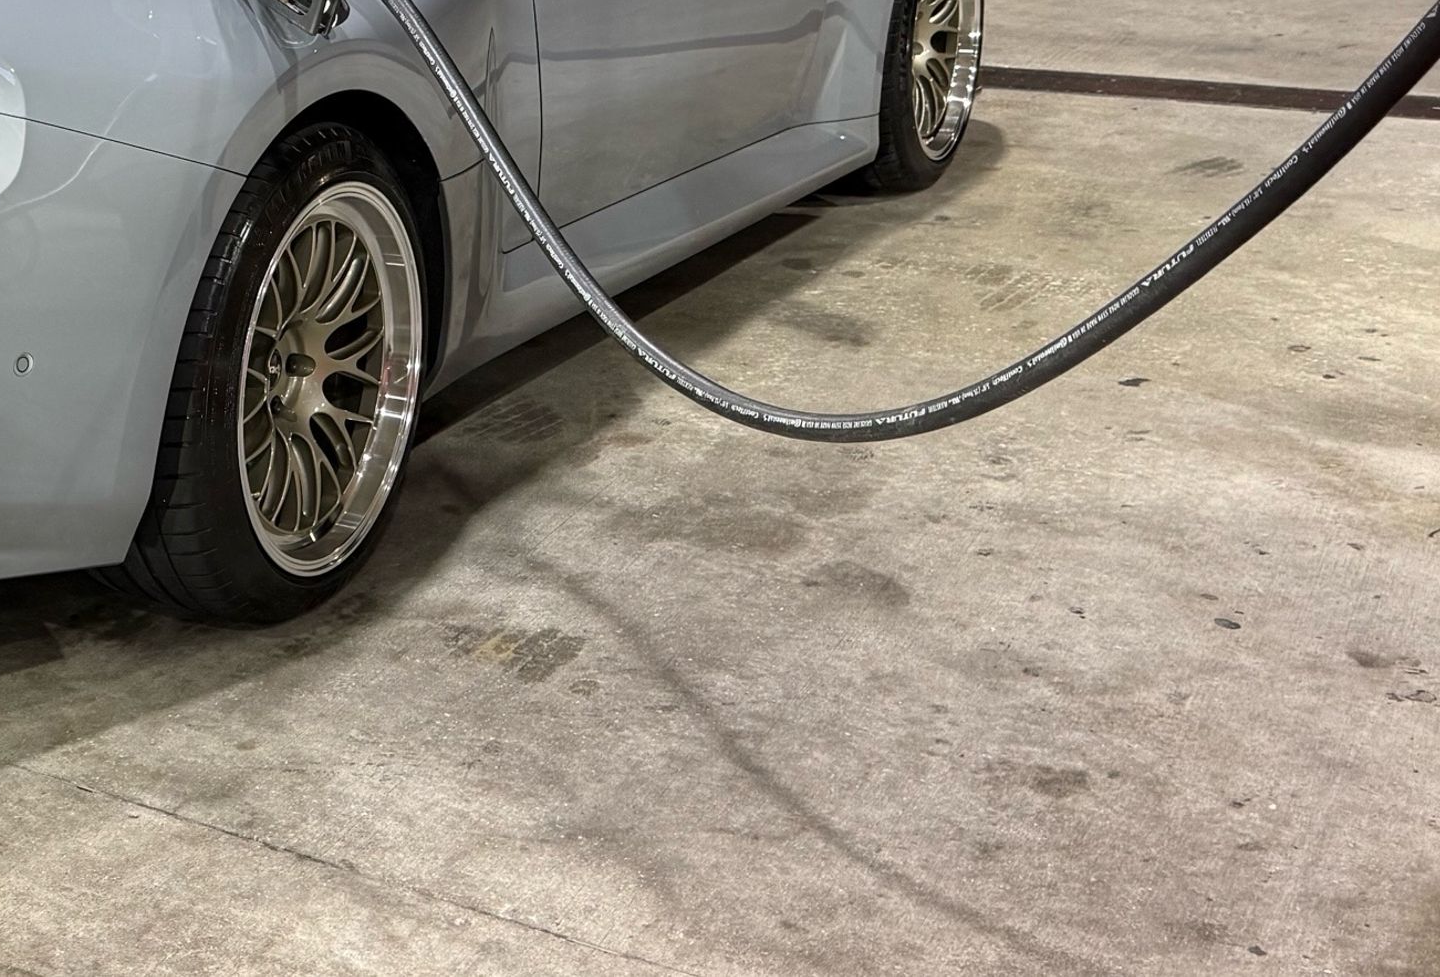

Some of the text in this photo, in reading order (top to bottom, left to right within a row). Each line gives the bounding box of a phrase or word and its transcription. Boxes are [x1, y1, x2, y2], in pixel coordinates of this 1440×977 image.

[485, 151, 515, 195] FUTURA
[1140, 242, 1196, 289] FUTURA
[634, 346, 677, 380] FUTURA
[875, 407, 926, 425] FUTURA
